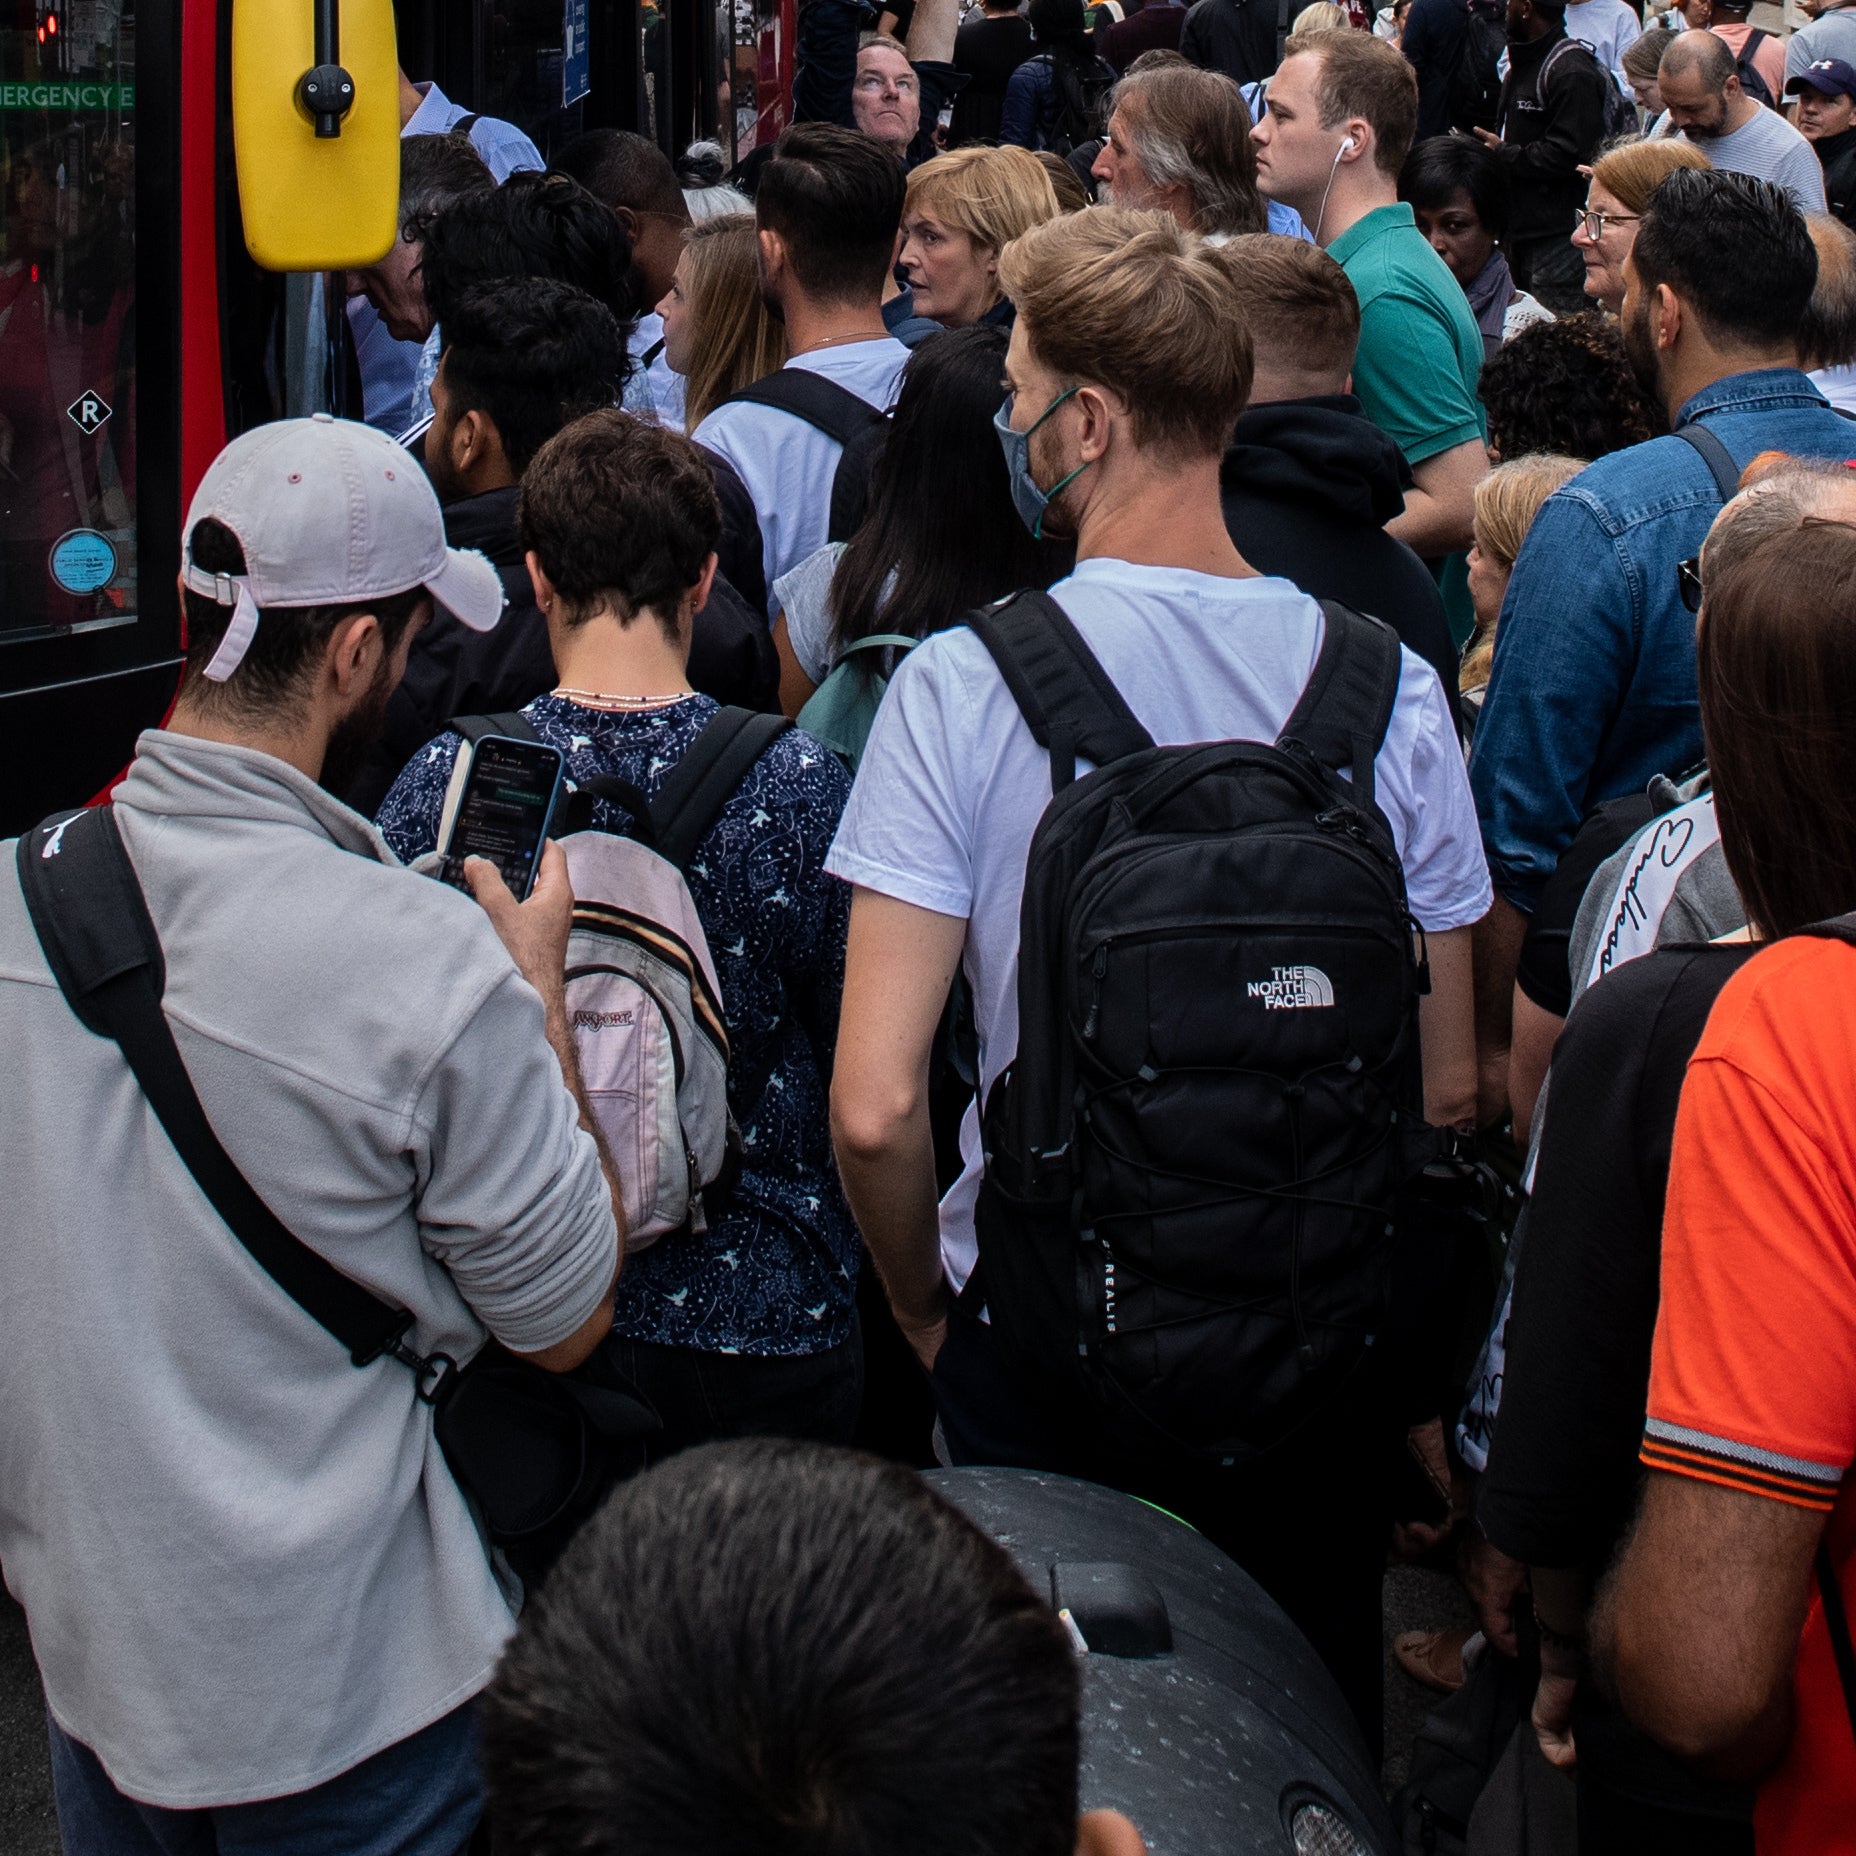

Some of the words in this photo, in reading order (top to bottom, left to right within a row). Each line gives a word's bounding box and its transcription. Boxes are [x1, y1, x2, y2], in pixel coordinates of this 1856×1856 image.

[82, 400, 99, 423] R
[1271, 966, 1304, 981] THE
[1247, 980, 1304, 997] NORTH
[1264, 993, 1305, 1010] FACE
[573, 1010, 632, 1032] ANSPORT
